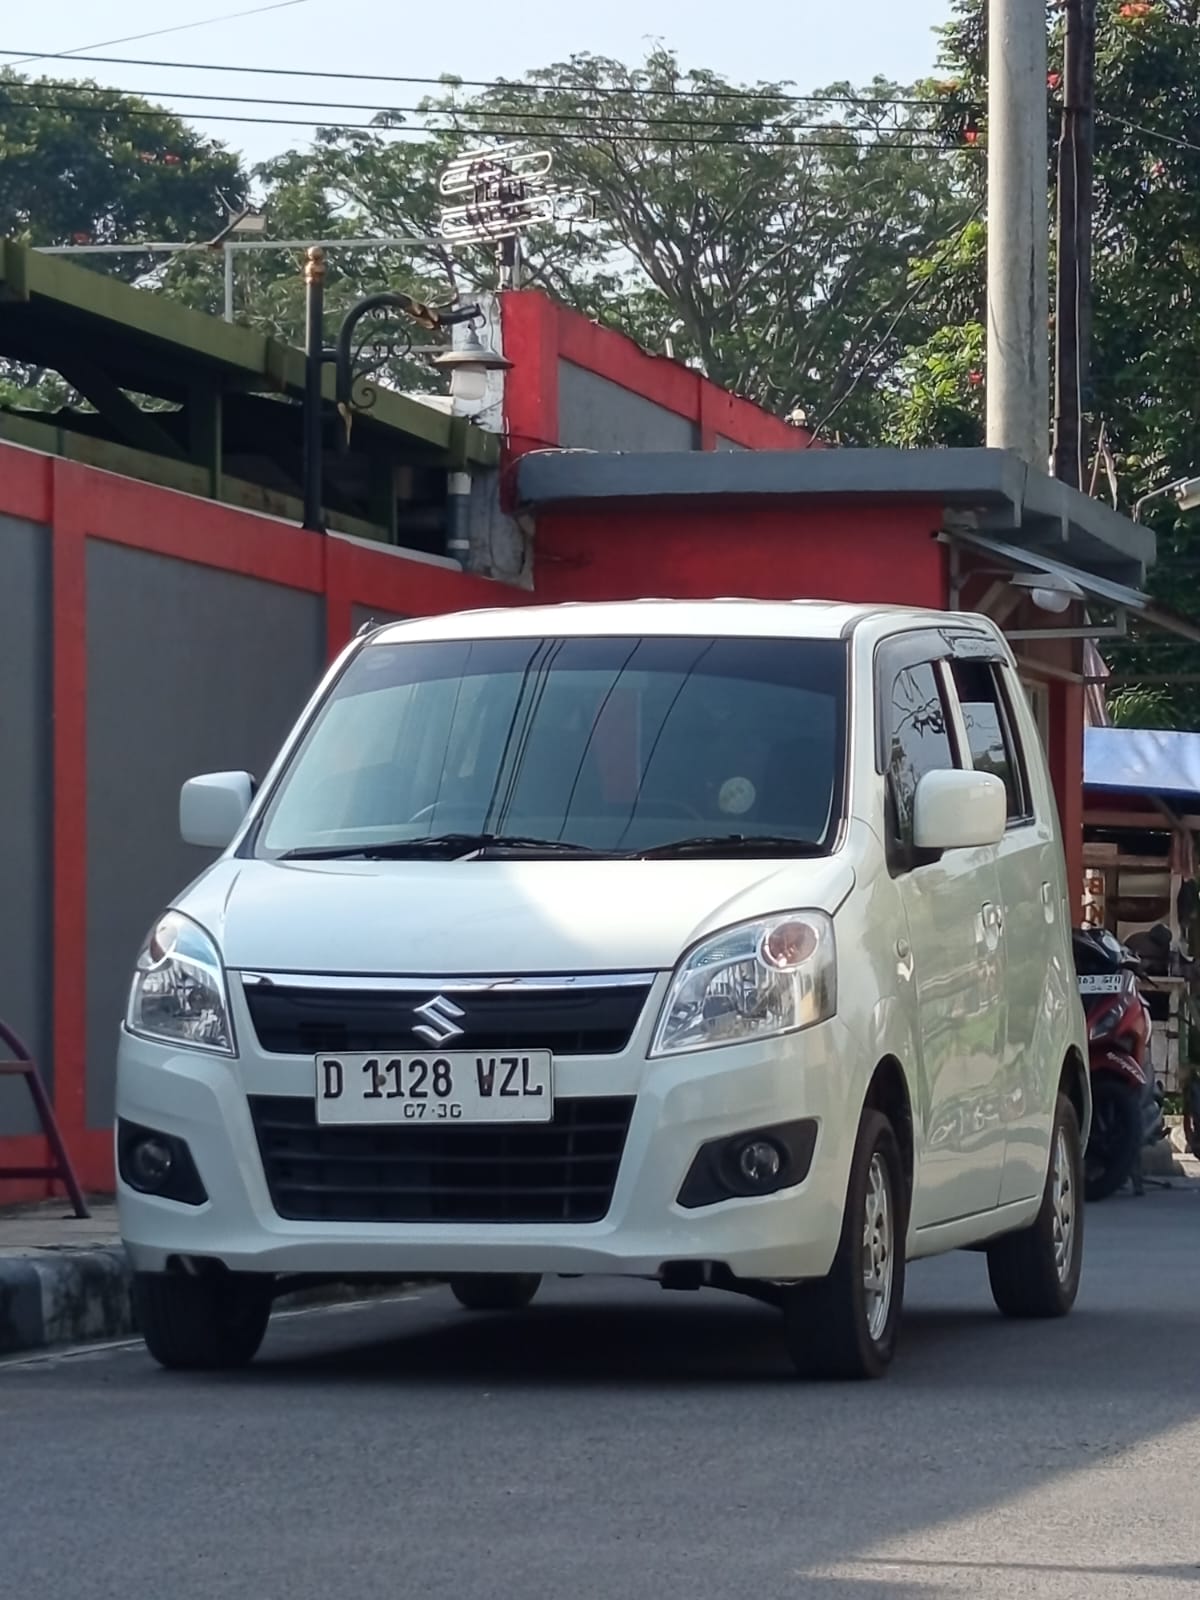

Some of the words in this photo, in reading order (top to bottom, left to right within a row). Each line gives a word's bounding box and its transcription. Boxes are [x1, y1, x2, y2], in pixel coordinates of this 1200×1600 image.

[322, 1060, 343, 1098] D
[362, 1058, 453, 1098] 1128
[476, 1057, 543, 1097] VZL
